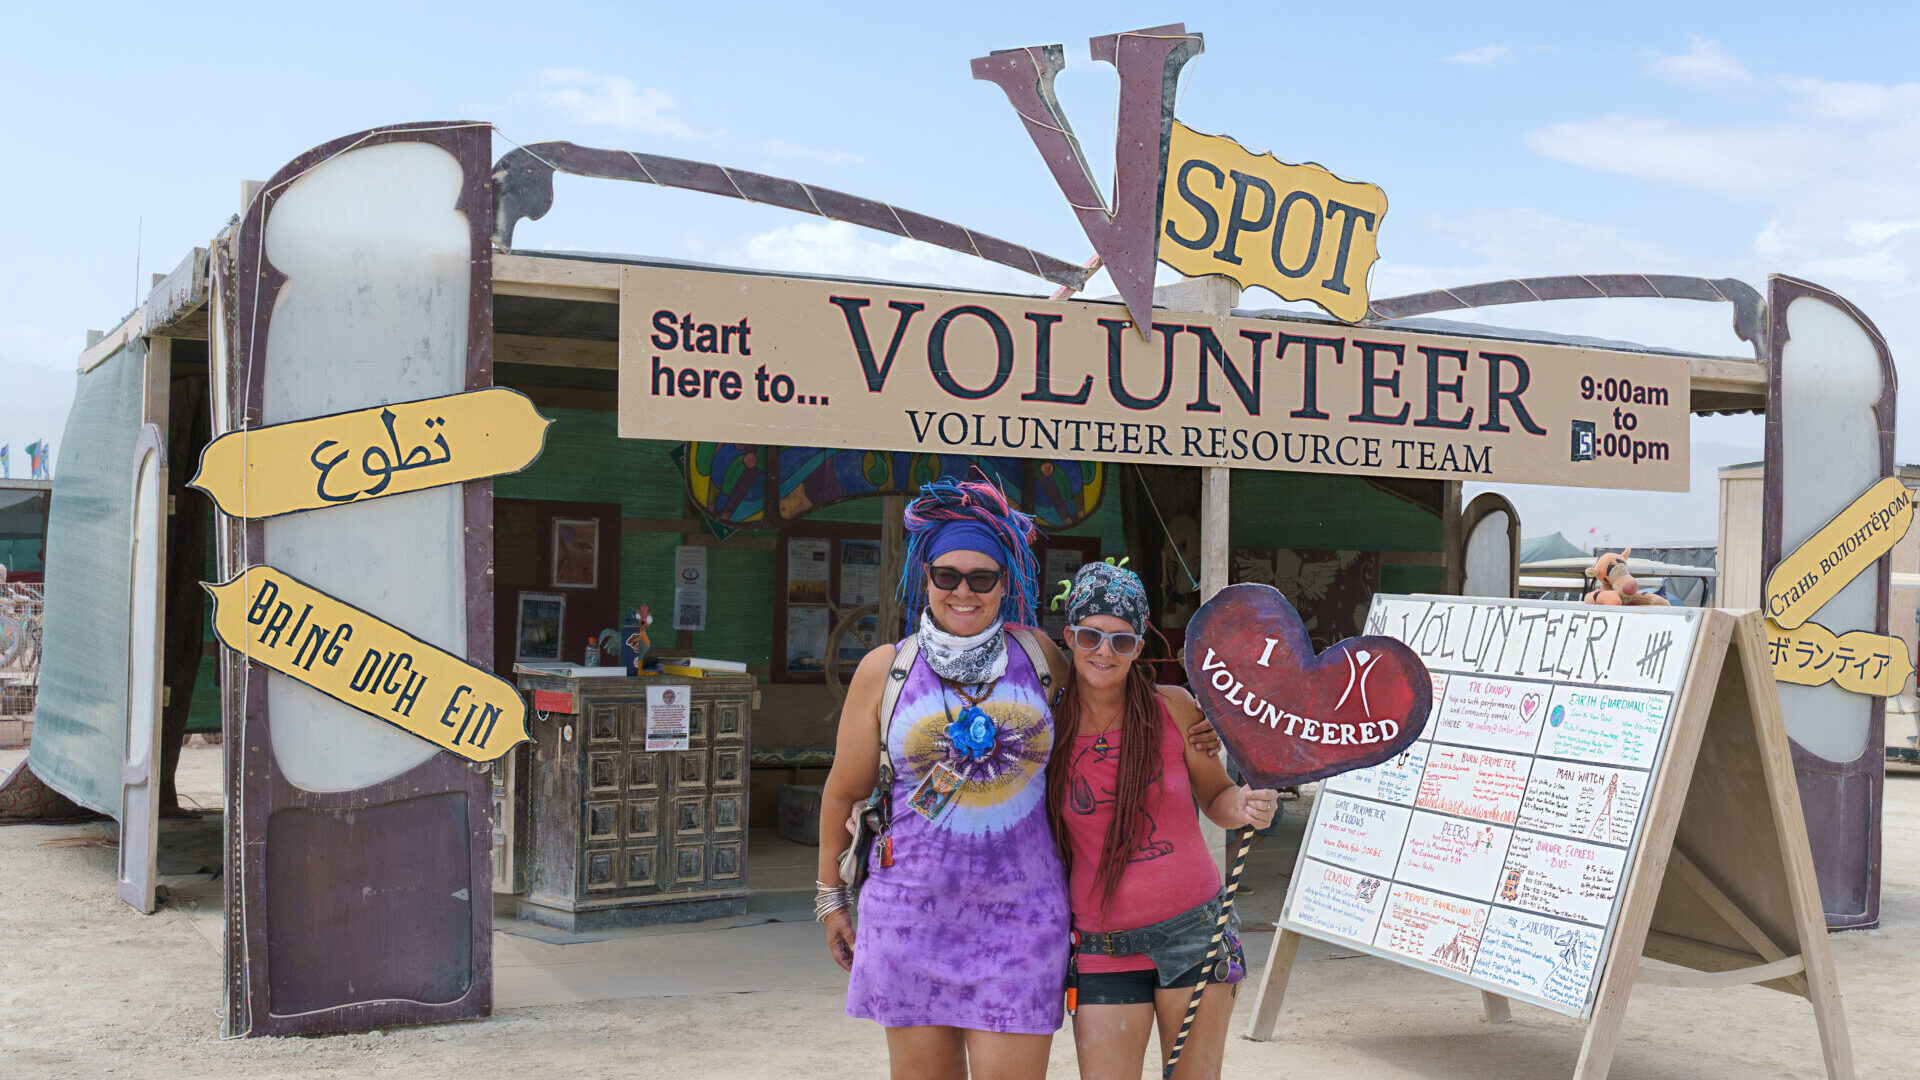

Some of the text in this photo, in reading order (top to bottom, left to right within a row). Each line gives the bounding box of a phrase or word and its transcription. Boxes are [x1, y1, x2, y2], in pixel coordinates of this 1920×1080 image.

[970, 23, 1204, 343] V
[1165, 159, 1376, 295] SPOT
[650, 310, 752, 357] Start
[650, 356, 829, 405] here to...
[829, 296, 1547, 436] VOLUNTEER
[1580, 377, 1669, 406] 9:00am
[1613, 408, 1637, 431] to
[310, 407, 452, 502] تطوع
[905, 411, 1494, 474] VOLUNTEER RESOURCE TEAM
[1579, 429, 1669, 464] 5:00pm
[1769, 490, 1910, 617] Стань волонтёром
[1257, 637, 1279, 667] I
[1401, 601, 1624, 682] VOLUNTEER!
[1768, 636, 1892, 680] ボランティア
[247, 579, 503, 750] BRING DICH EIN
[1202, 647, 1399, 745] VOLUNTEERED
[1569, 693, 1597, 707] EARTH
[1462, 753, 1478, 764] BURN
[1556, 768, 1605, 785] MAN WATCH
[1441, 822, 1470, 840] PEERS
[1324, 868, 1352, 888] CENSUS
[1521, 920, 1560, 939] AIRPORT
